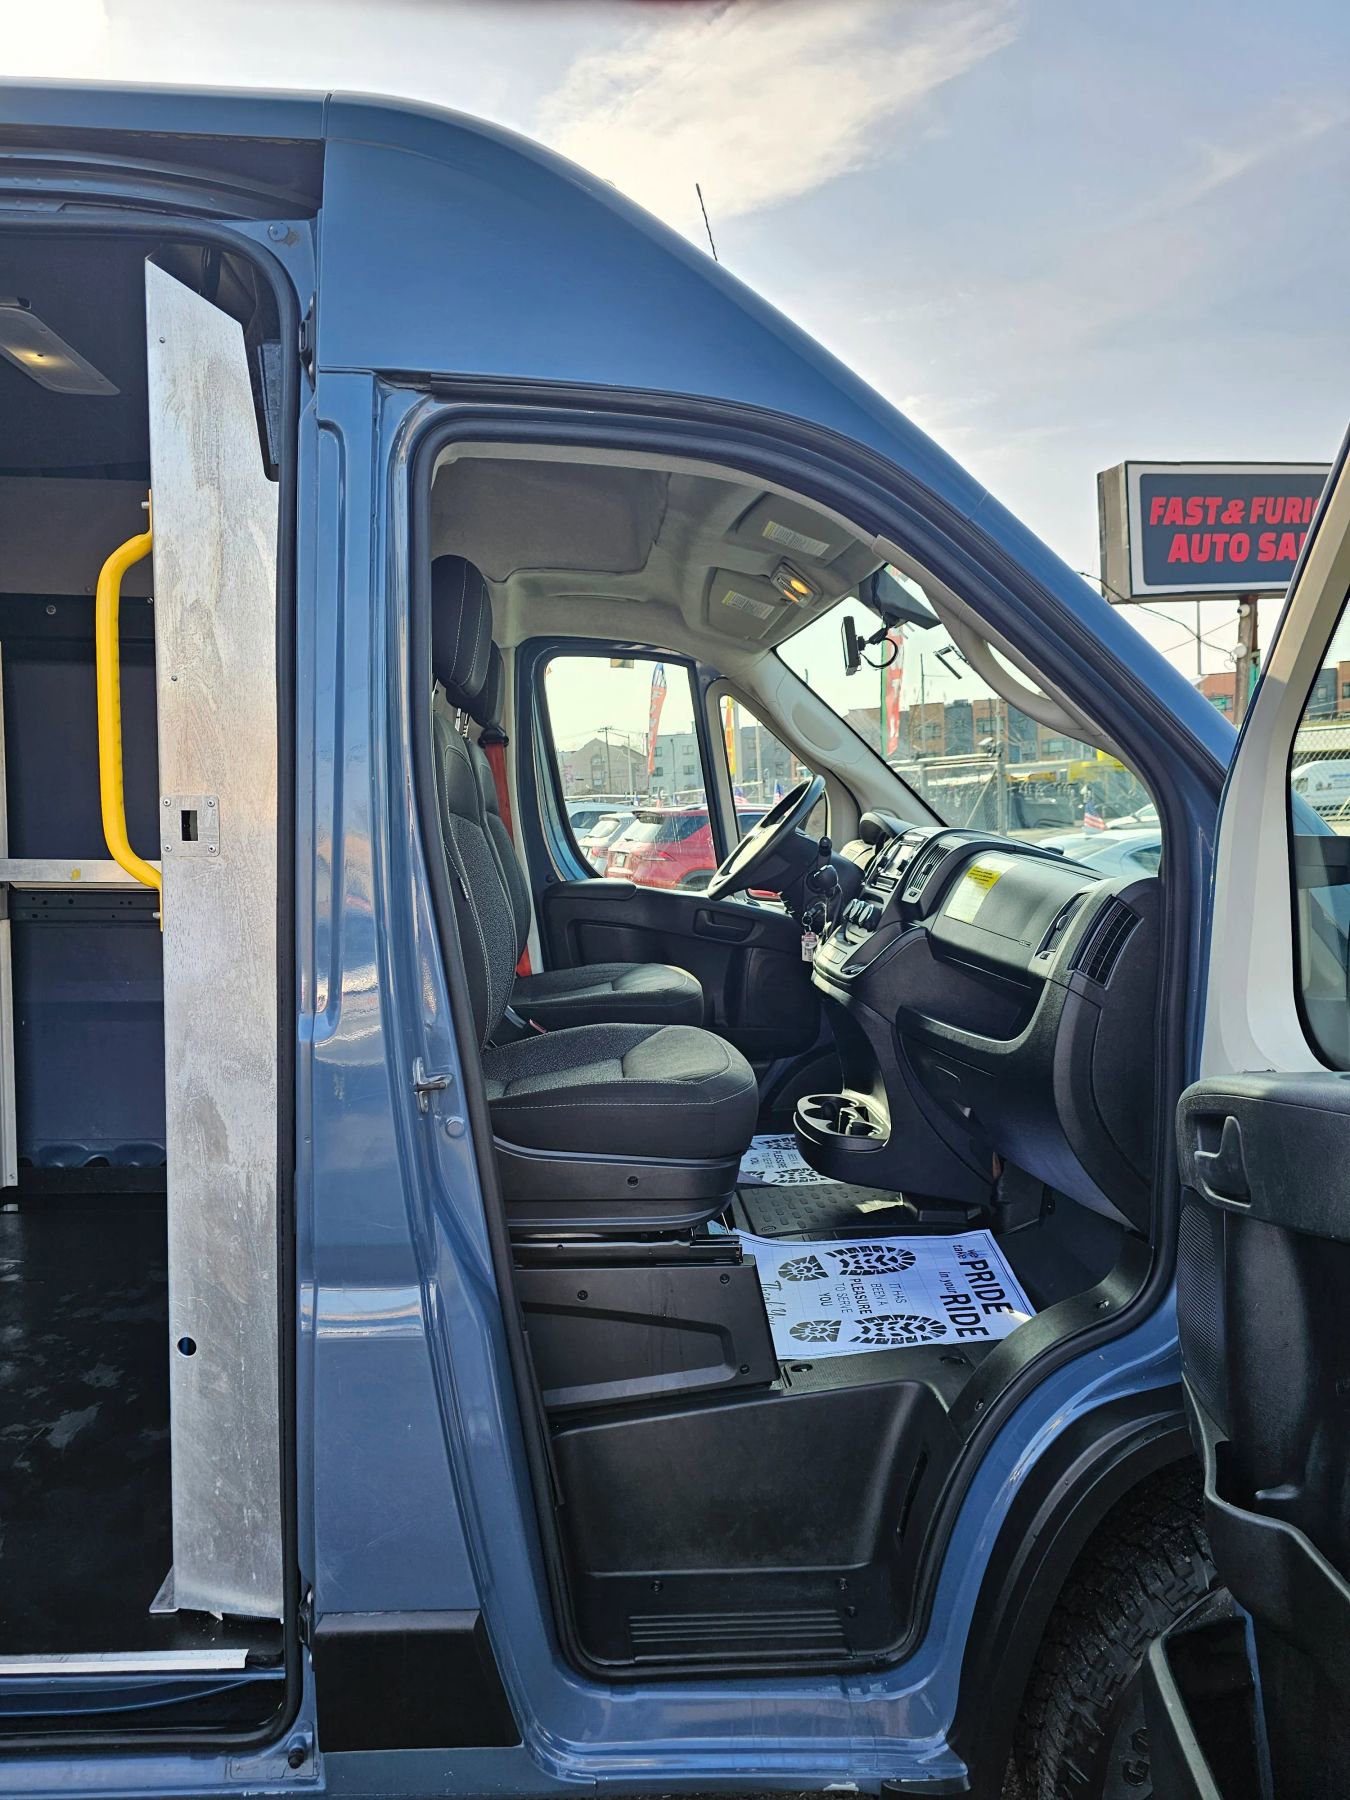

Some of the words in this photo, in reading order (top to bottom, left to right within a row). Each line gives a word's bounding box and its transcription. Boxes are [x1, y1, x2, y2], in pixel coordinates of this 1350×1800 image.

[1150, 496, 1222, 526] FAST
[1220, 499, 1245, 525] &
[1167, 532, 1250, 563] AUTO
[952, 1244, 967, 1259] take
[939, 1271, 951, 1279] in
[834, 1282, 847, 1292] TO
[870, 1283, 886, 1300] BEEN
[940, 1278, 958, 1294] your
[959, 1259, 1015, 1315] PRIDE
[819, 1292, 833, 1307] YOU
[836, 1292, 853, 1314] SERVE
[850, 1278, 872, 1315] PLEASURE
[892, 1290, 907, 1304] HAS
[940, 1293, 990, 1338] RIDE
